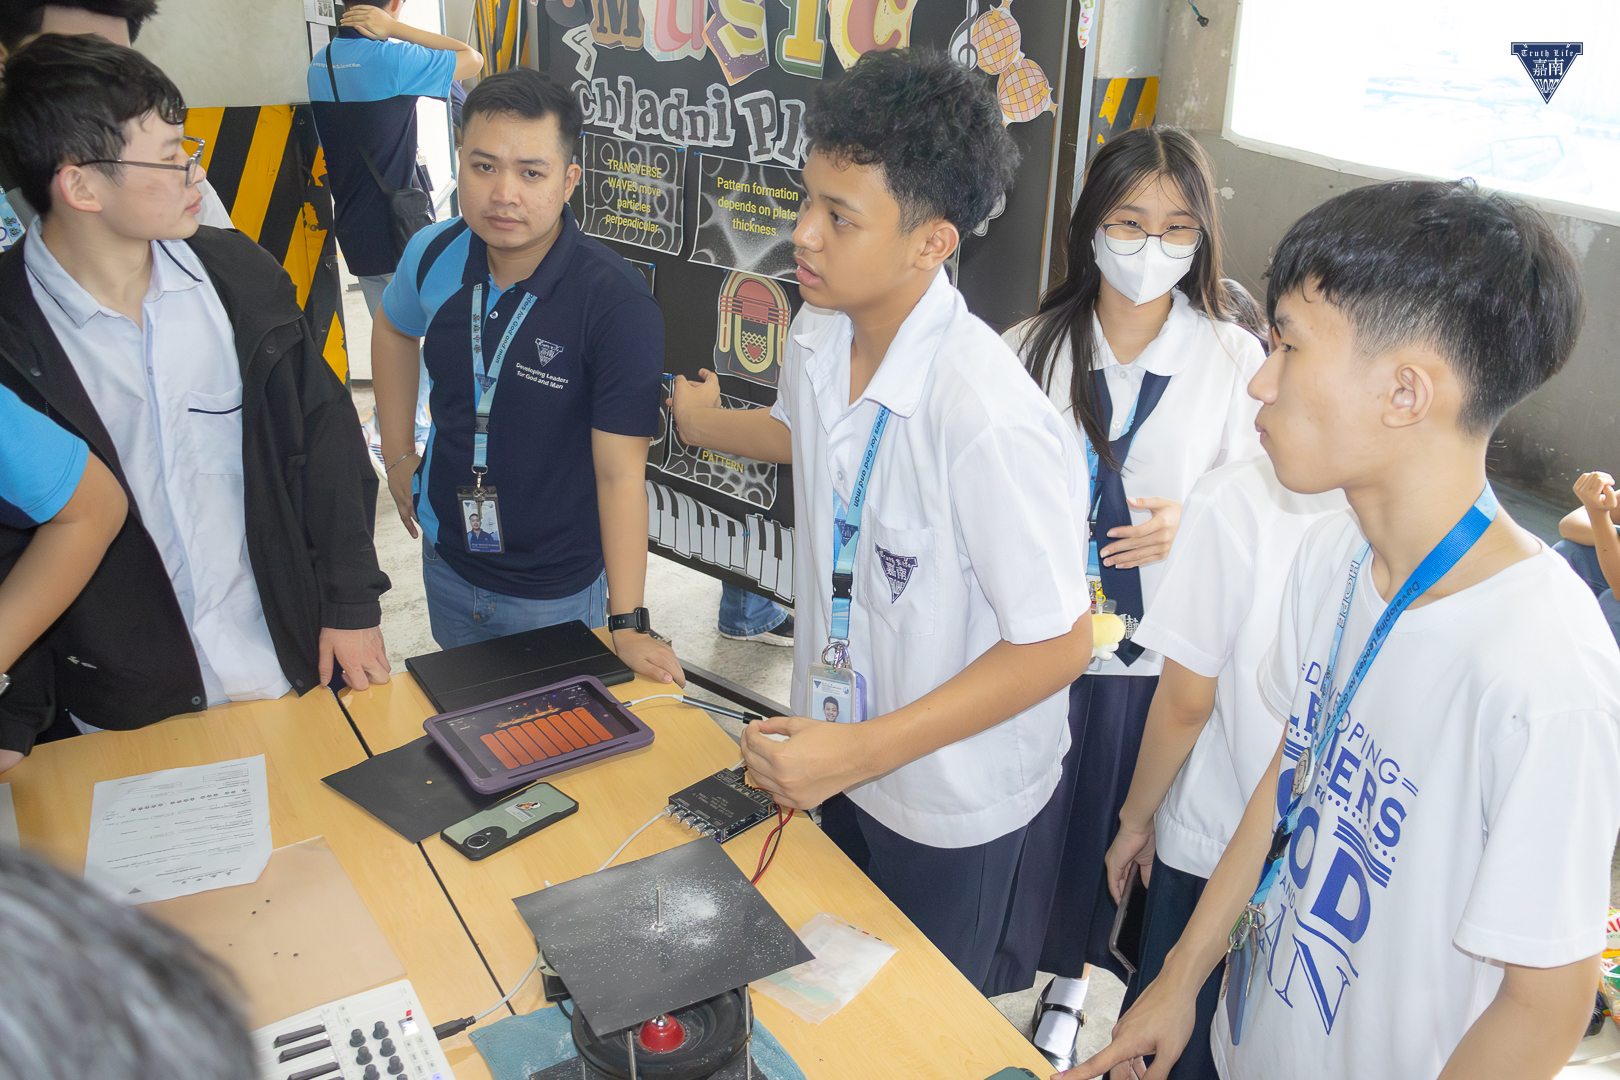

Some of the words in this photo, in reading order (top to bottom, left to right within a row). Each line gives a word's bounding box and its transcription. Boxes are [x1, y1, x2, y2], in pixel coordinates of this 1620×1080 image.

[608, 159, 662, 179] TRANSVERSE
[608, 177, 637, 192] WAVES
[639, 185, 661, 197] move
[717, 176, 750, 194] Pattern
[752, 182, 799, 201] formation
[617, 196, 651, 213] particles
[718, 197, 756, 215] depends
[758, 206, 771, 216] on
[773, 206, 797, 221] plate
[605, 214, 661, 233] perpendicular.
[732, 218, 779, 237] thickness.
[508, 321, 518, 336] God
[501, 335, 511, 350] and
[516, 362, 545, 378] Developing
[546, 373, 569, 384] Leaders
[517, 370, 525, 378] for
[525, 374, 537, 382] God
[537, 377, 549, 386] and
[550, 381, 564, 389] Man
[869, 436, 878, 449] for
[702, 450, 744, 473] PATTERN
[863, 449, 873, 470] God
[858, 469, 867, 488] and
[853, 487, 862, 508] man
[1375, 581, 1420, 637] Developing
[1355, 636, 1377, 676] Leaders
[1279, 875, 1296, 909] AND
